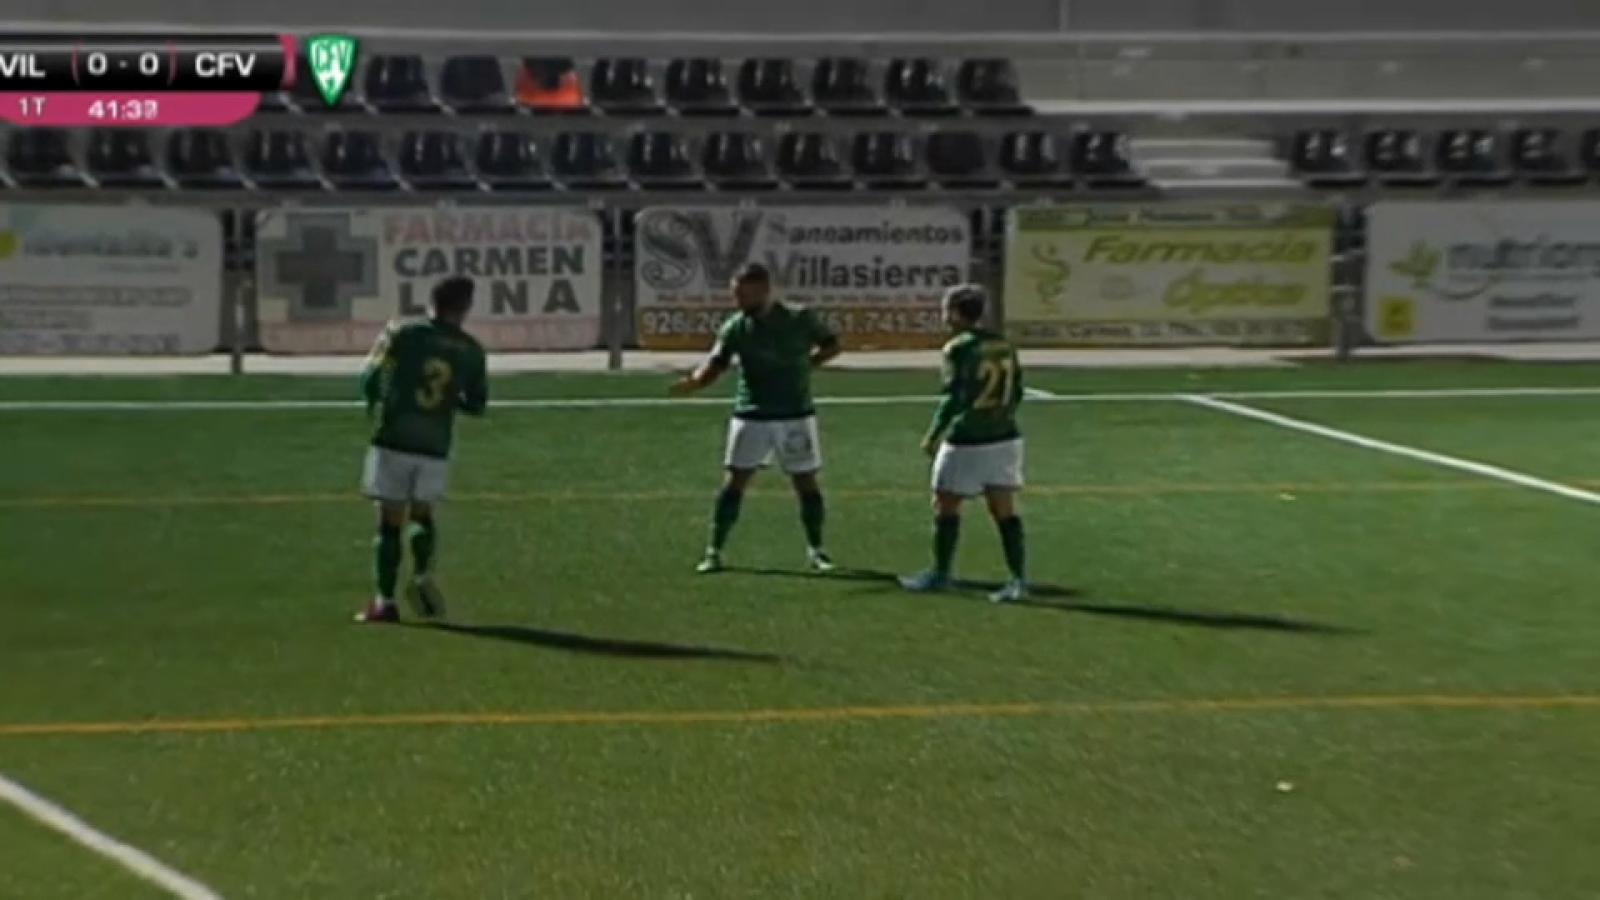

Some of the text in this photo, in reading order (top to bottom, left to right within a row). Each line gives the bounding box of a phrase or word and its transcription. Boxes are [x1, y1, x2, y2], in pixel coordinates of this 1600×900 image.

[766, 214, 965, 245] Saneamientos
[394, 246, 586, 277] CARMEN
[1083, 233, 1320, 264] Farmacia
[765, 252, 962, 290] Villasierra
[397, 280, 582, 316] LNA
[414, 357, 453, 408] 3
[973, 358, 1014, 406] 21
